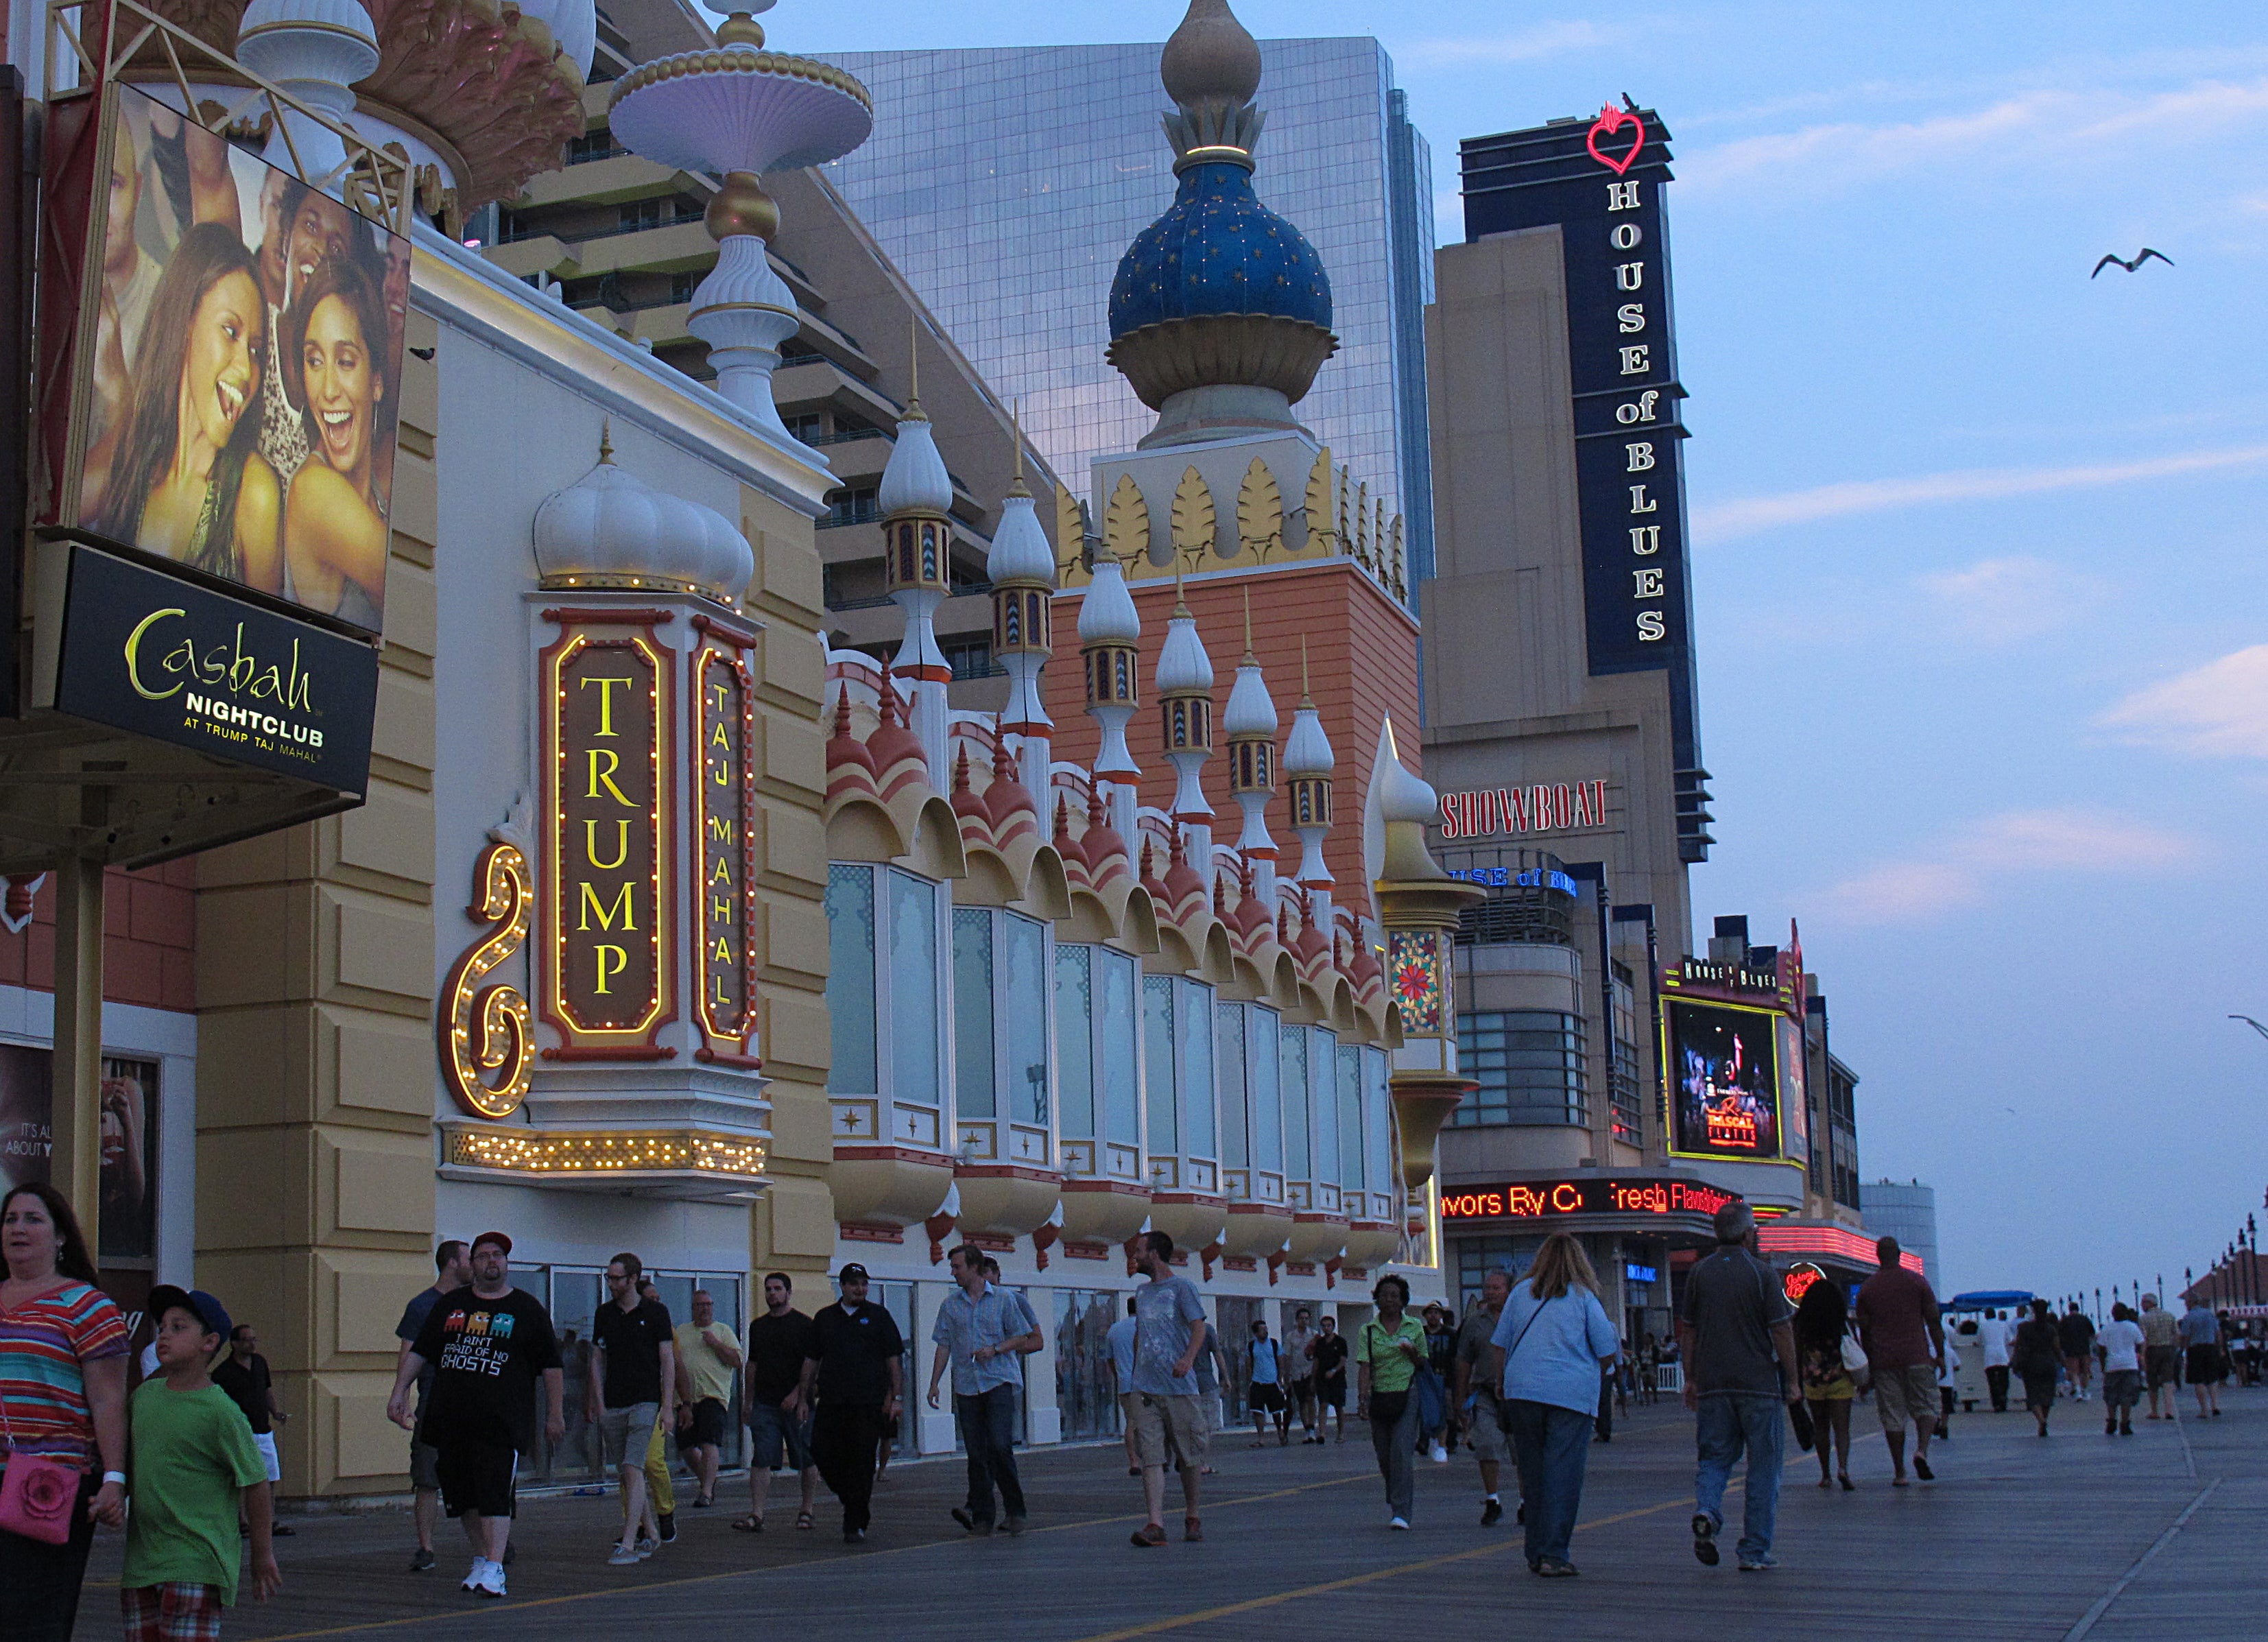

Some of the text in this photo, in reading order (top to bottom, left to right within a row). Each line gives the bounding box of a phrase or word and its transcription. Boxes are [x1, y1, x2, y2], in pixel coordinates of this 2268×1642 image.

[1607, 180, 1665, 641] HOUSE of BLUES
[124, 608, 311, 713] Casbah
[186, 692, 324, 748] NIGHTCLUB
[184, 717, 316, 763] AT TRUMP TAJ MAHAL
[1440, 779, 1608, 839] SHOWBOAT
[575, 676, 642, 995] TRUMP
[711, 683, 732, 1006] TAJ MAHAL
[1516, 868, 1542, 886] of
[1684, 962, 1723, 980] HOUSE
[1740, 969, 1777, 988] BLUES
[21, 1123, 38, 1138] IT'S
[1707, 1114, 1755, 1129] RASCAL
[1708, 1126, 1756, 1141] FLATTS
[5, 1141, 52, 1157] ABOUT Y
[1610, 1182, 1667, 1213] resh
[455, 1333, 492, 1347] I AIN'T
[440, 1354, 502, 1376] GHOSTS
[475, 1347, 490, 1357] OF
[493, 1350, 509, 1363] NO
